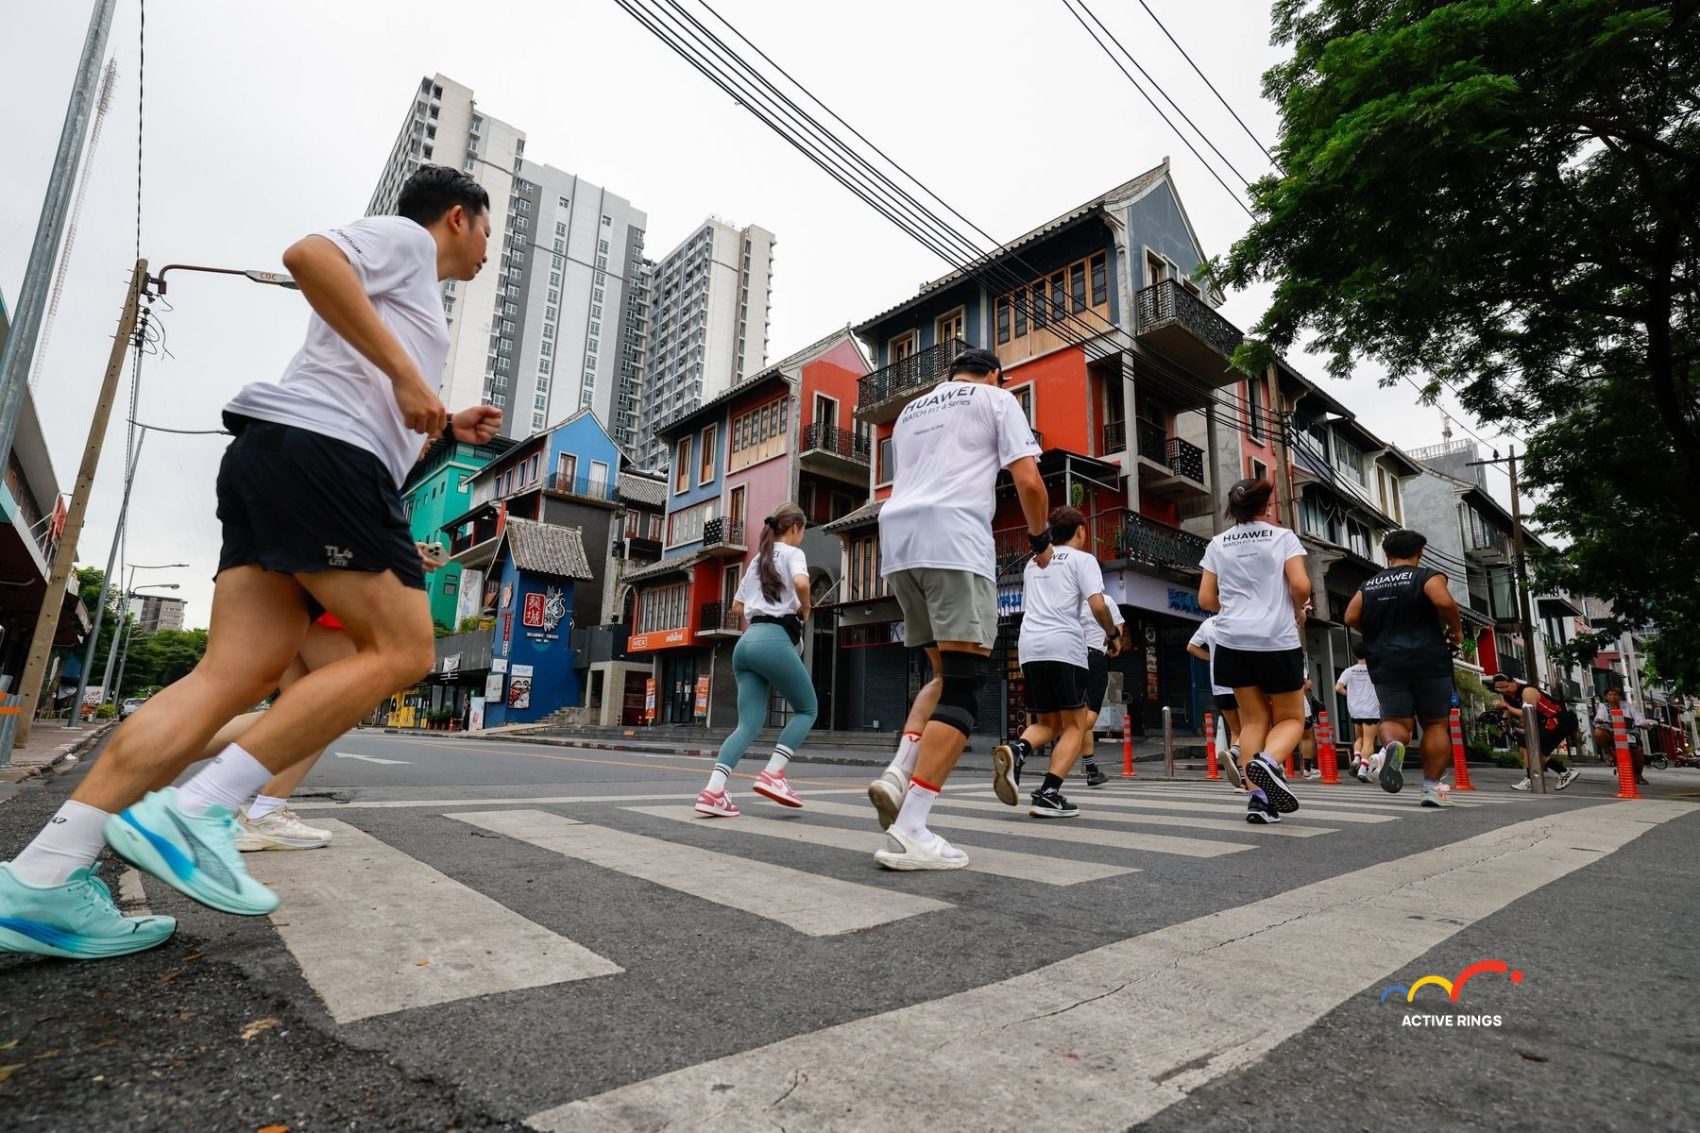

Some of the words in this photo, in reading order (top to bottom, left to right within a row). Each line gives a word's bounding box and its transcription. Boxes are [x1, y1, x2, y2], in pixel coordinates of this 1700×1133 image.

[904, 386, 976, 414] HUAWEI
[902, 409, 927, 423] WATCH
[927, 405, 941, 415] FIT
[947, 399, 971, 409] Series
[1223, 530, 1273, 542] HUAWEI
[1366, 571, 1413, 586] HUAWEI
